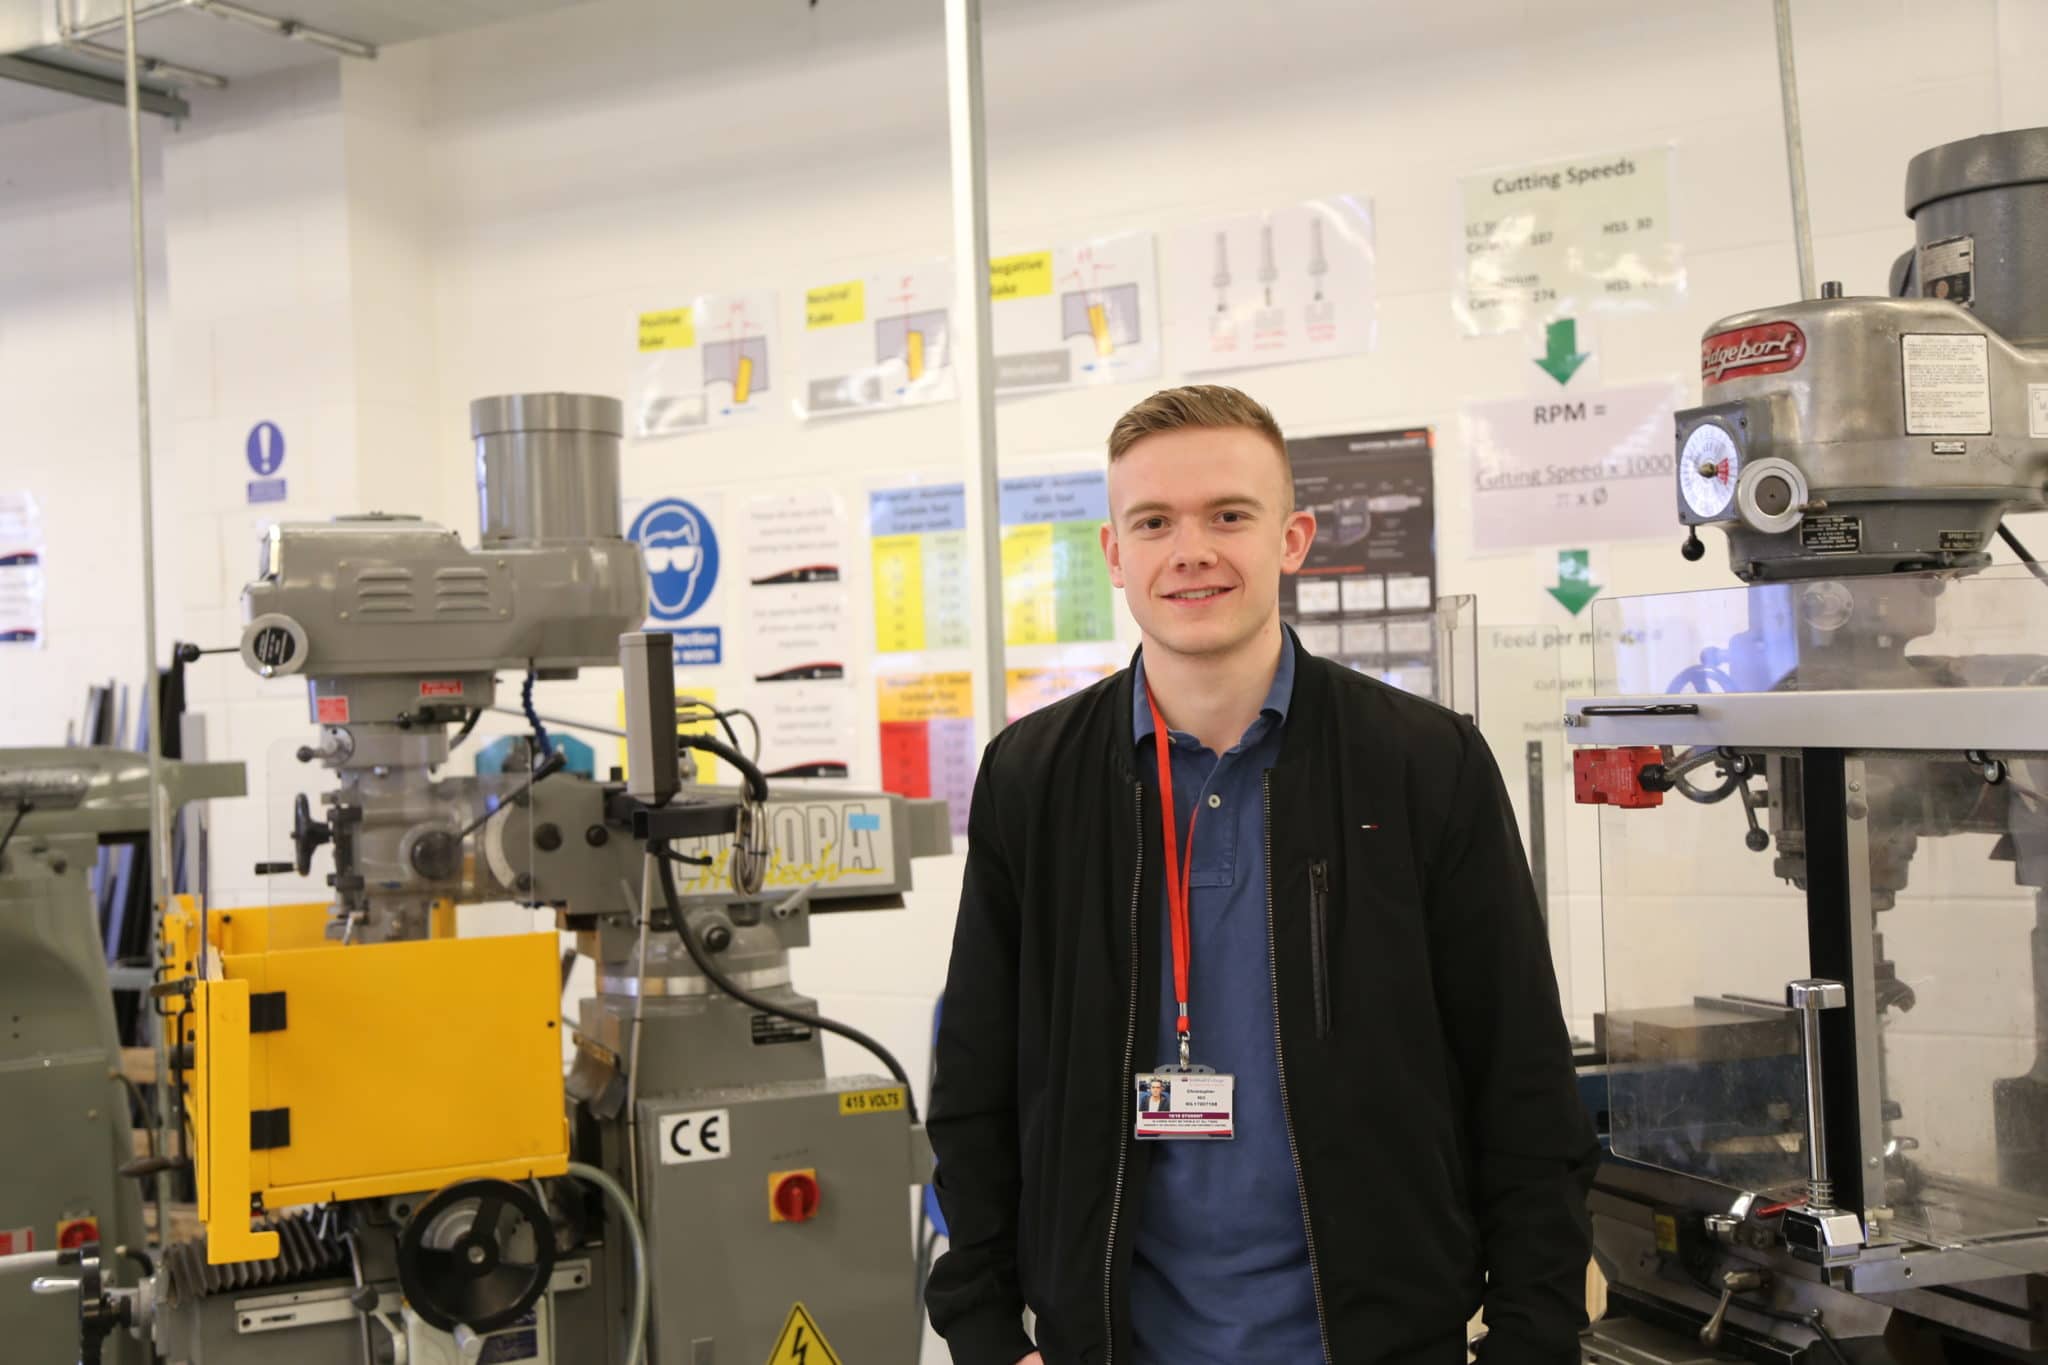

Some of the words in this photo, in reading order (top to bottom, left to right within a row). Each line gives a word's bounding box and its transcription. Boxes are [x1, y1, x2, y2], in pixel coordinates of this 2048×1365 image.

[1492, 169, 1560, 195] Cutting
[1567, 157, 1636, 185] Speeds
[1533, 402, 1587, 425] RPM
[1545, 463, 1604, 485] Speed
[1627, 454, 1674, 474] 1000
[1543, 630, 1572, 650] per
[845, 1095, 866, 1109] 415
[868, 1091, 900, 1108] VOLTS
[670, 1115, 721, 1157] CE
